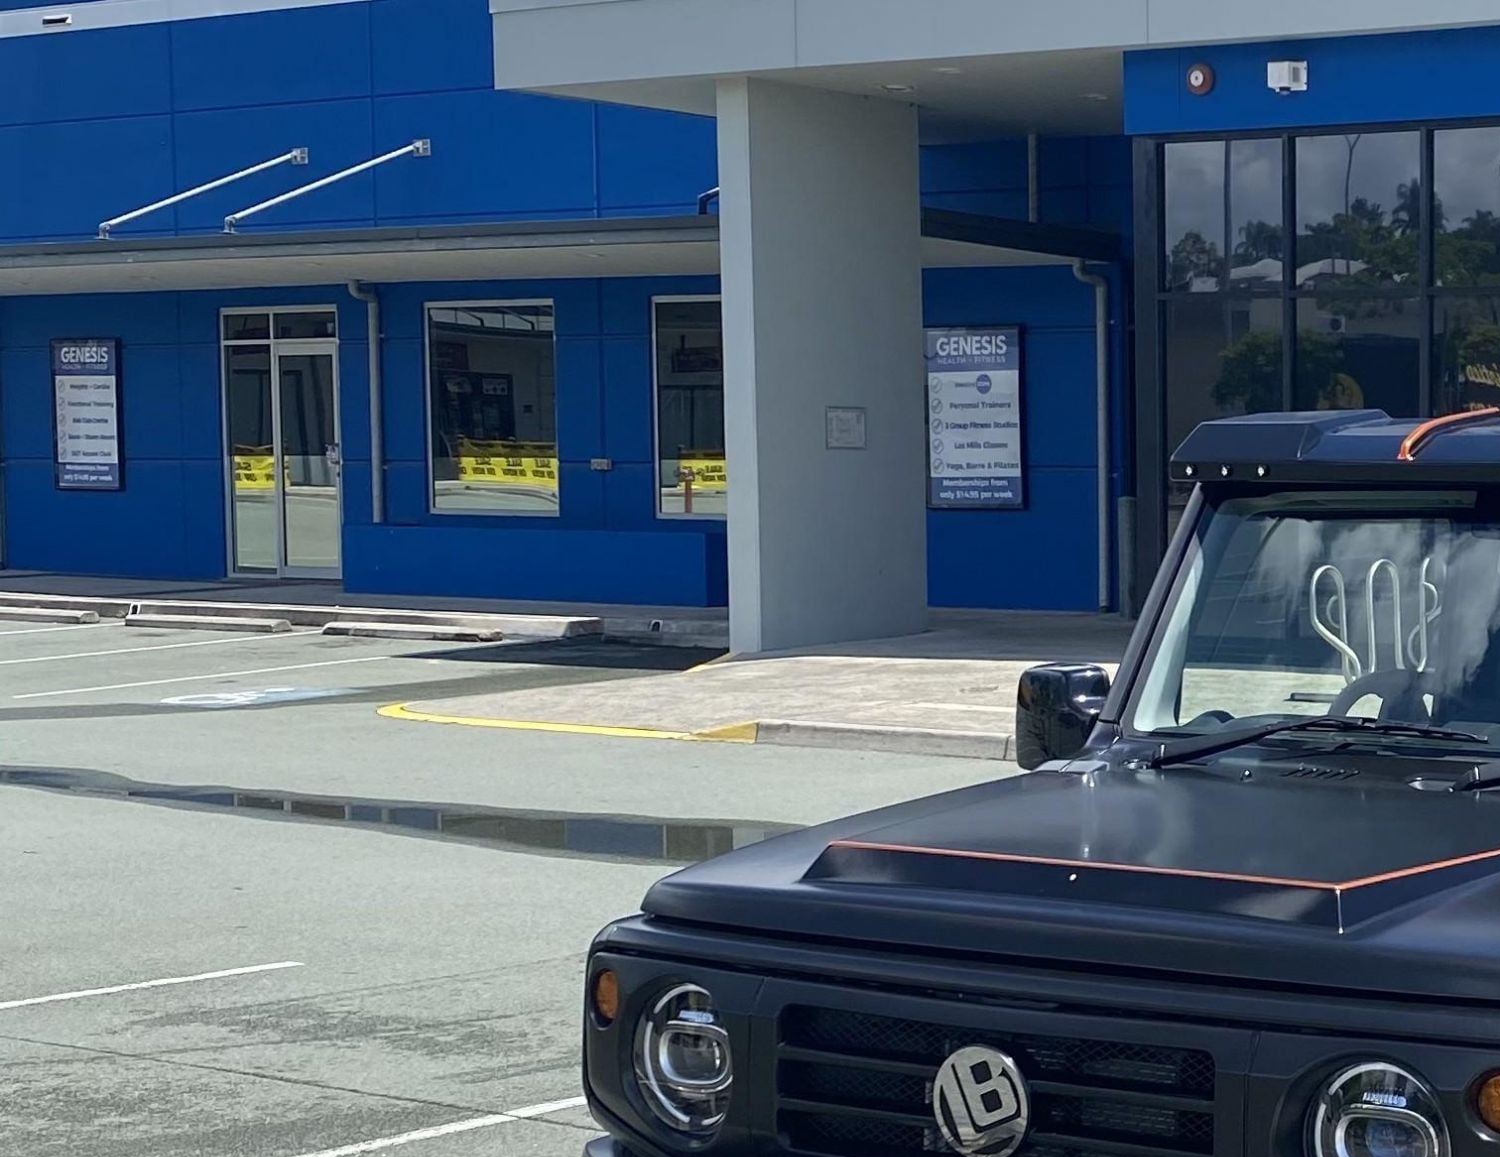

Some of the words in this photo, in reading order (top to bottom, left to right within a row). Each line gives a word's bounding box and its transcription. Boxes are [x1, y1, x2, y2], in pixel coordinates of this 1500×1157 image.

[936, 335, 1008, 356] GENESIS
[61, 347, 108, 363] GENESIS
[937, 356, 966, 365] HEALTH
[974, 355, 1006, 364] FITNESS
[950, 401, 979, 410] Personal
[981, 400, 1011, 408] Trainers
